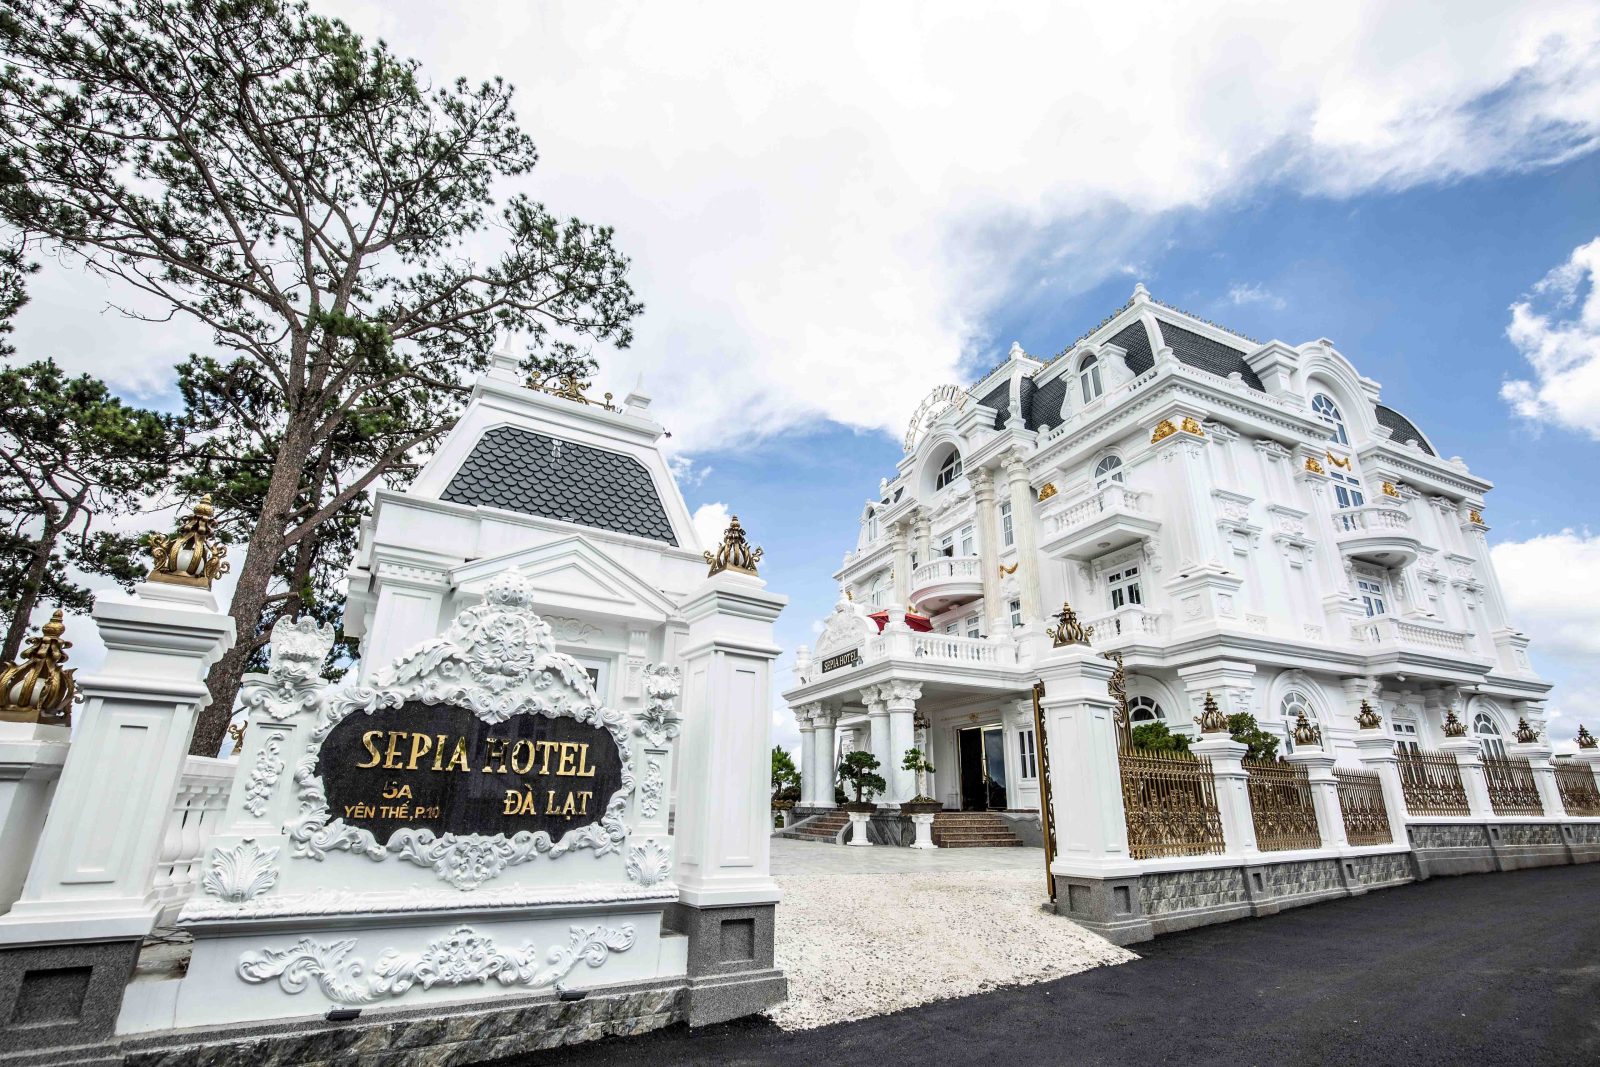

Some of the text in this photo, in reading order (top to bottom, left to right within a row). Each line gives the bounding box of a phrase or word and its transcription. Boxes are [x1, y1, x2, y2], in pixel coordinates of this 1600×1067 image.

[824, 650, 858, 671] SEPIA HOTEL
[356, 730, 596, 777] SEPIA HOTEL
[382, 781, 413, 799] 5A
[344, 802, 376, 819] YÊN
[503, 783, 593, 820] ĐÀ LẠT
